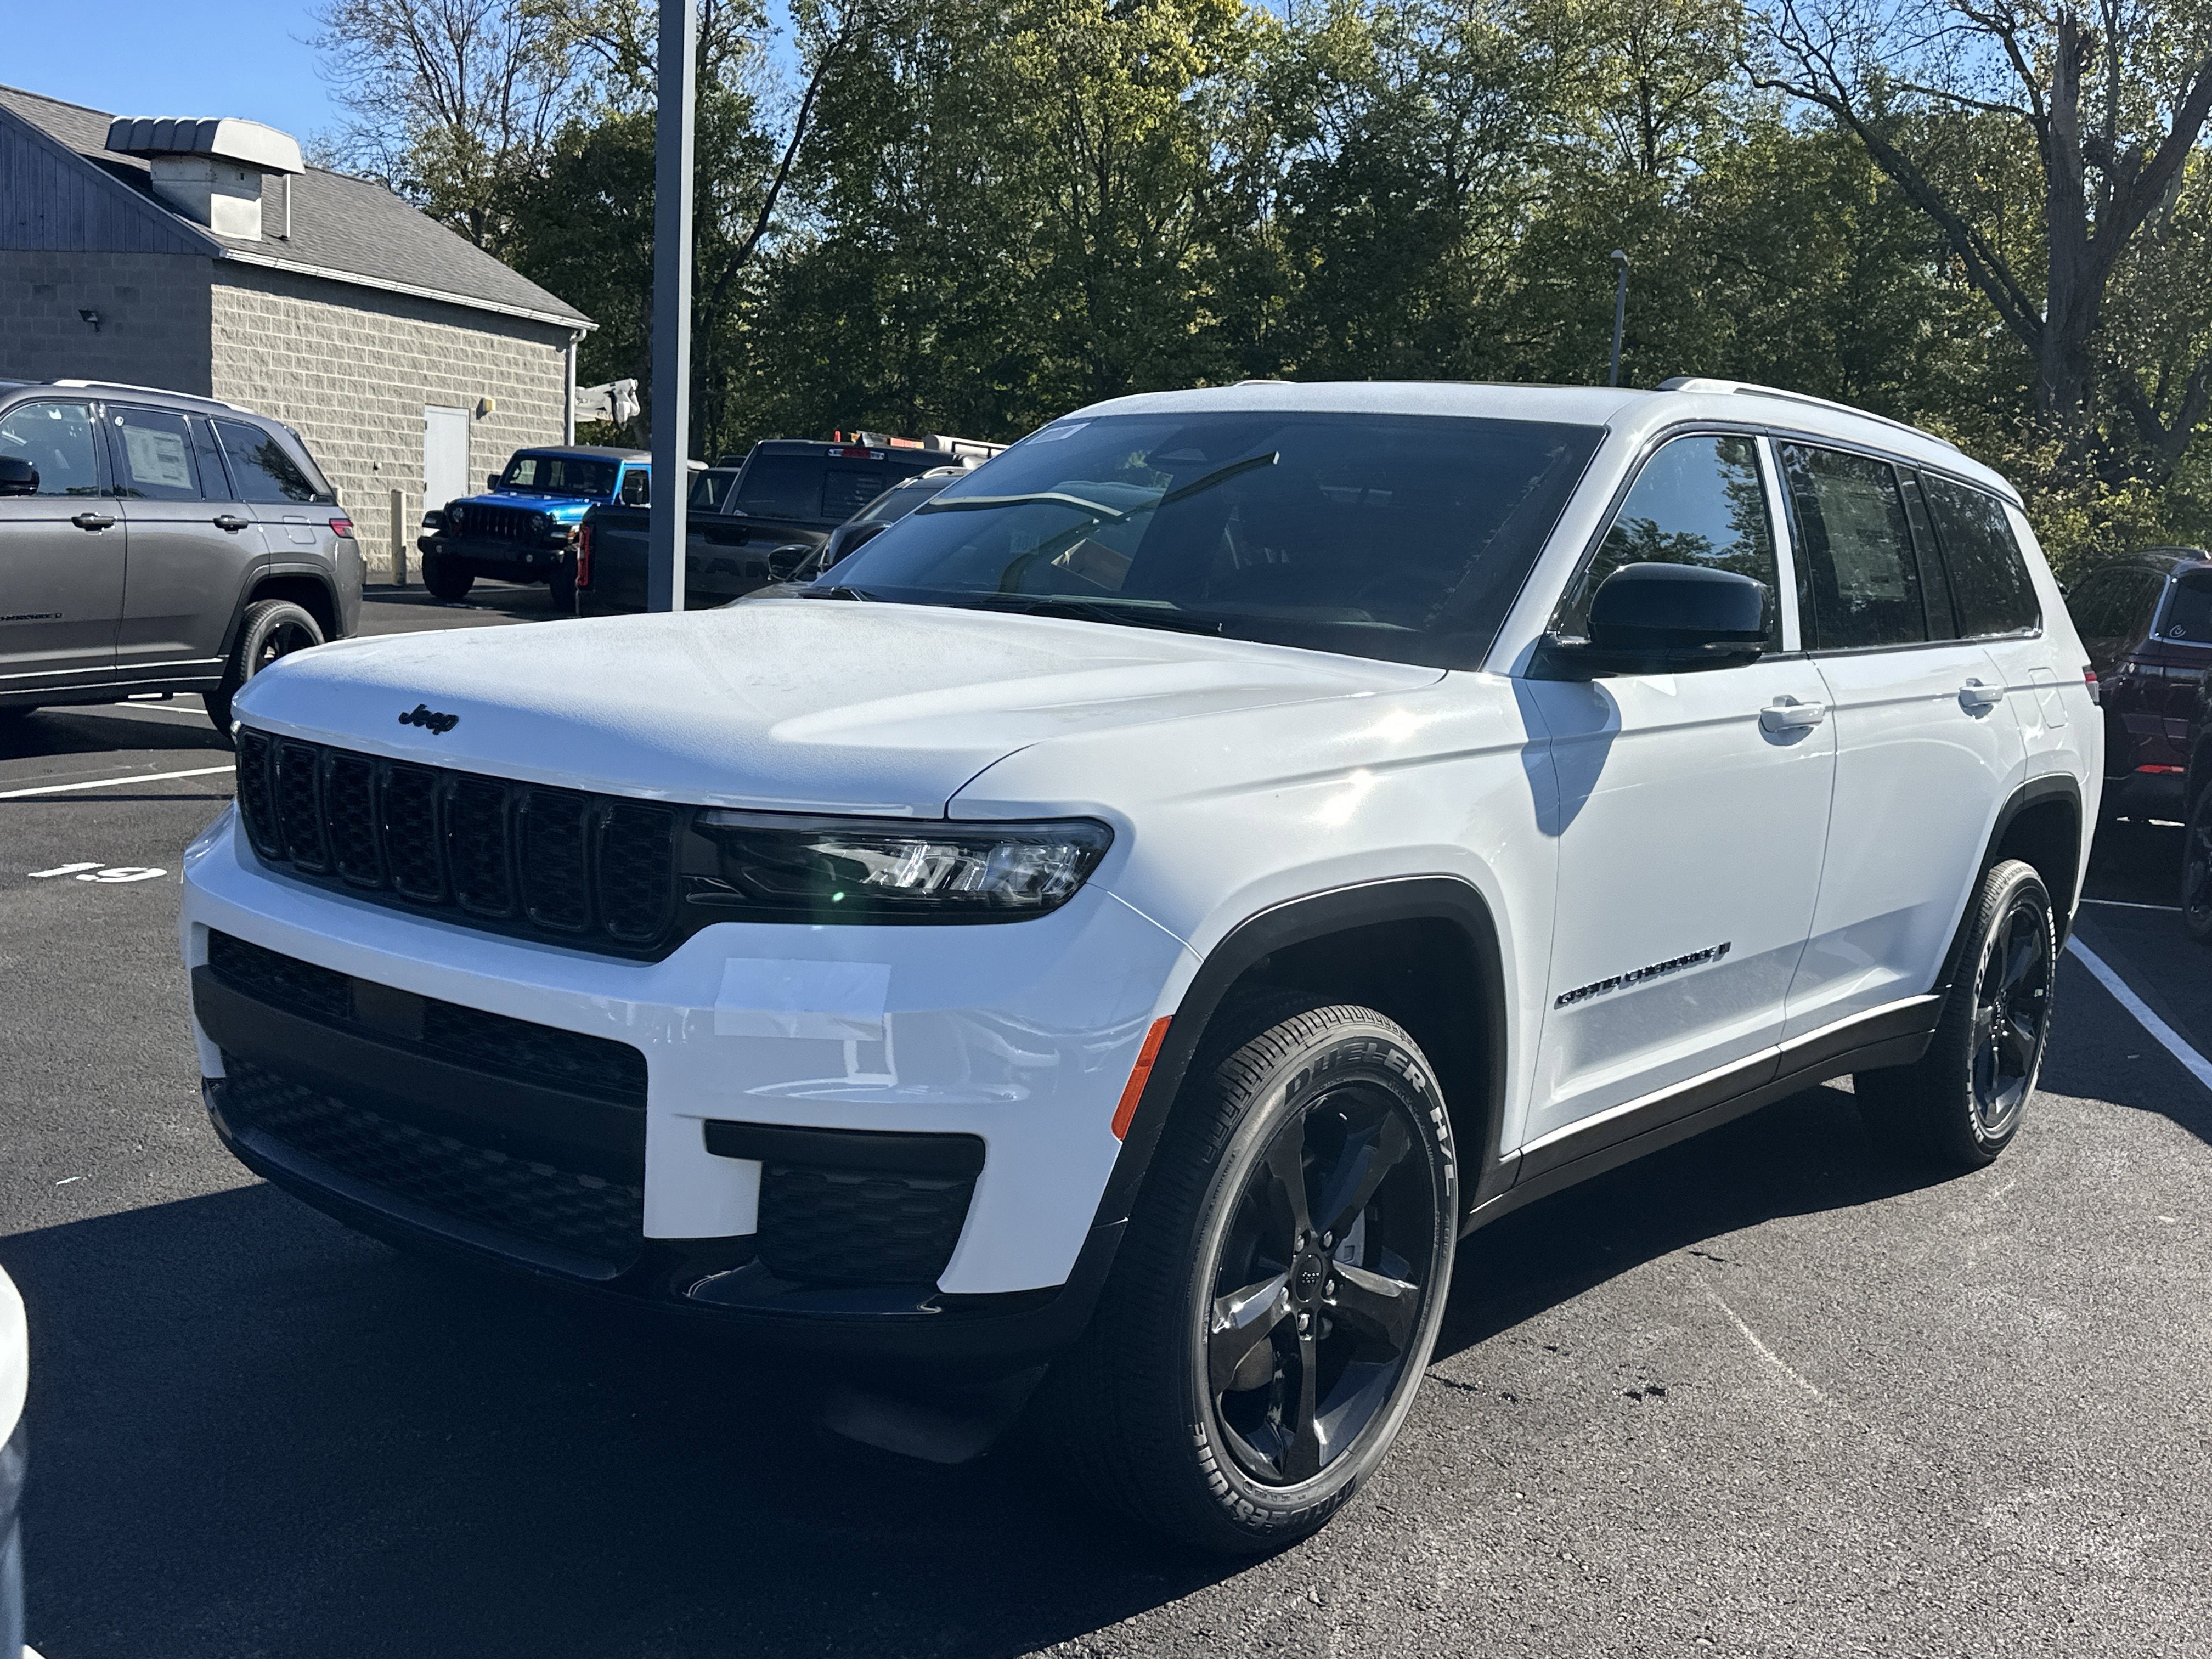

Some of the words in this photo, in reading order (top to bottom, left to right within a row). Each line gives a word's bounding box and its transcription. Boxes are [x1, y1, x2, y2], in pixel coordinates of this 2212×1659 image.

[399, 703, 460, 735] Jeep
[28, 862, 167, 883] 19
[1284, 1042, 1426, 1107] DUELER
[1430, 1107, 1454, 1197] H/L
